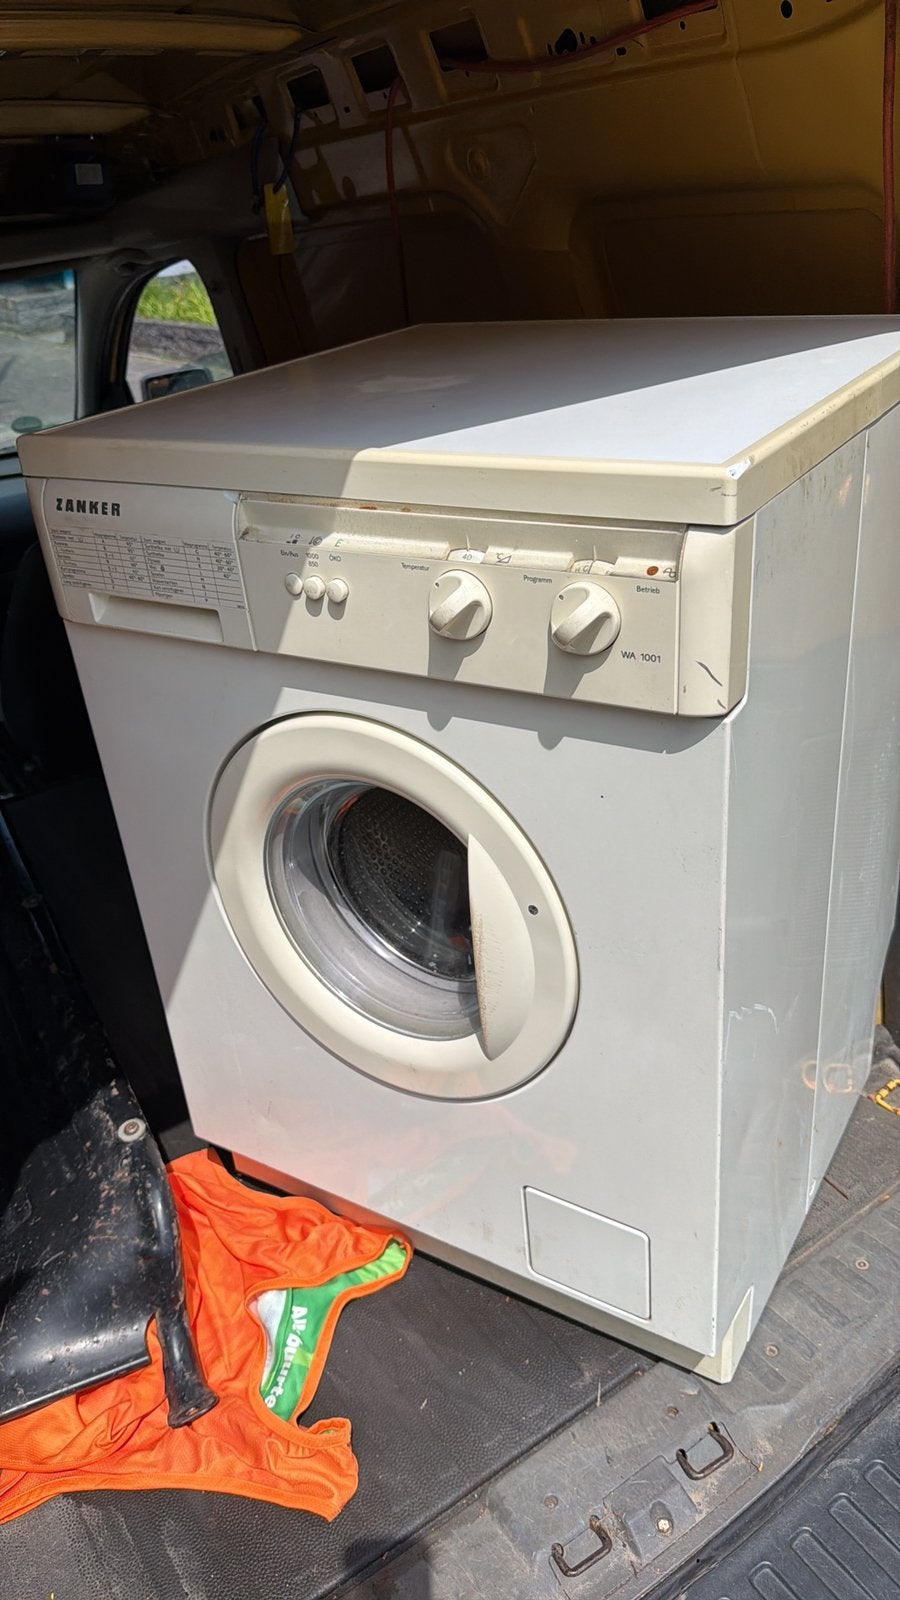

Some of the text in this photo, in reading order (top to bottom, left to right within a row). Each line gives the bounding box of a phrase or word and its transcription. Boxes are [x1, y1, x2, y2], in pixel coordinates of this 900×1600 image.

[56, 497, 121, 517] ZANKER
[462, 553, 473, 561] 40
[523, 574, 553, 584] Programm
[636, 585, 661, 594] Betrieb
[621, 650, 661, 663] WA 1001
